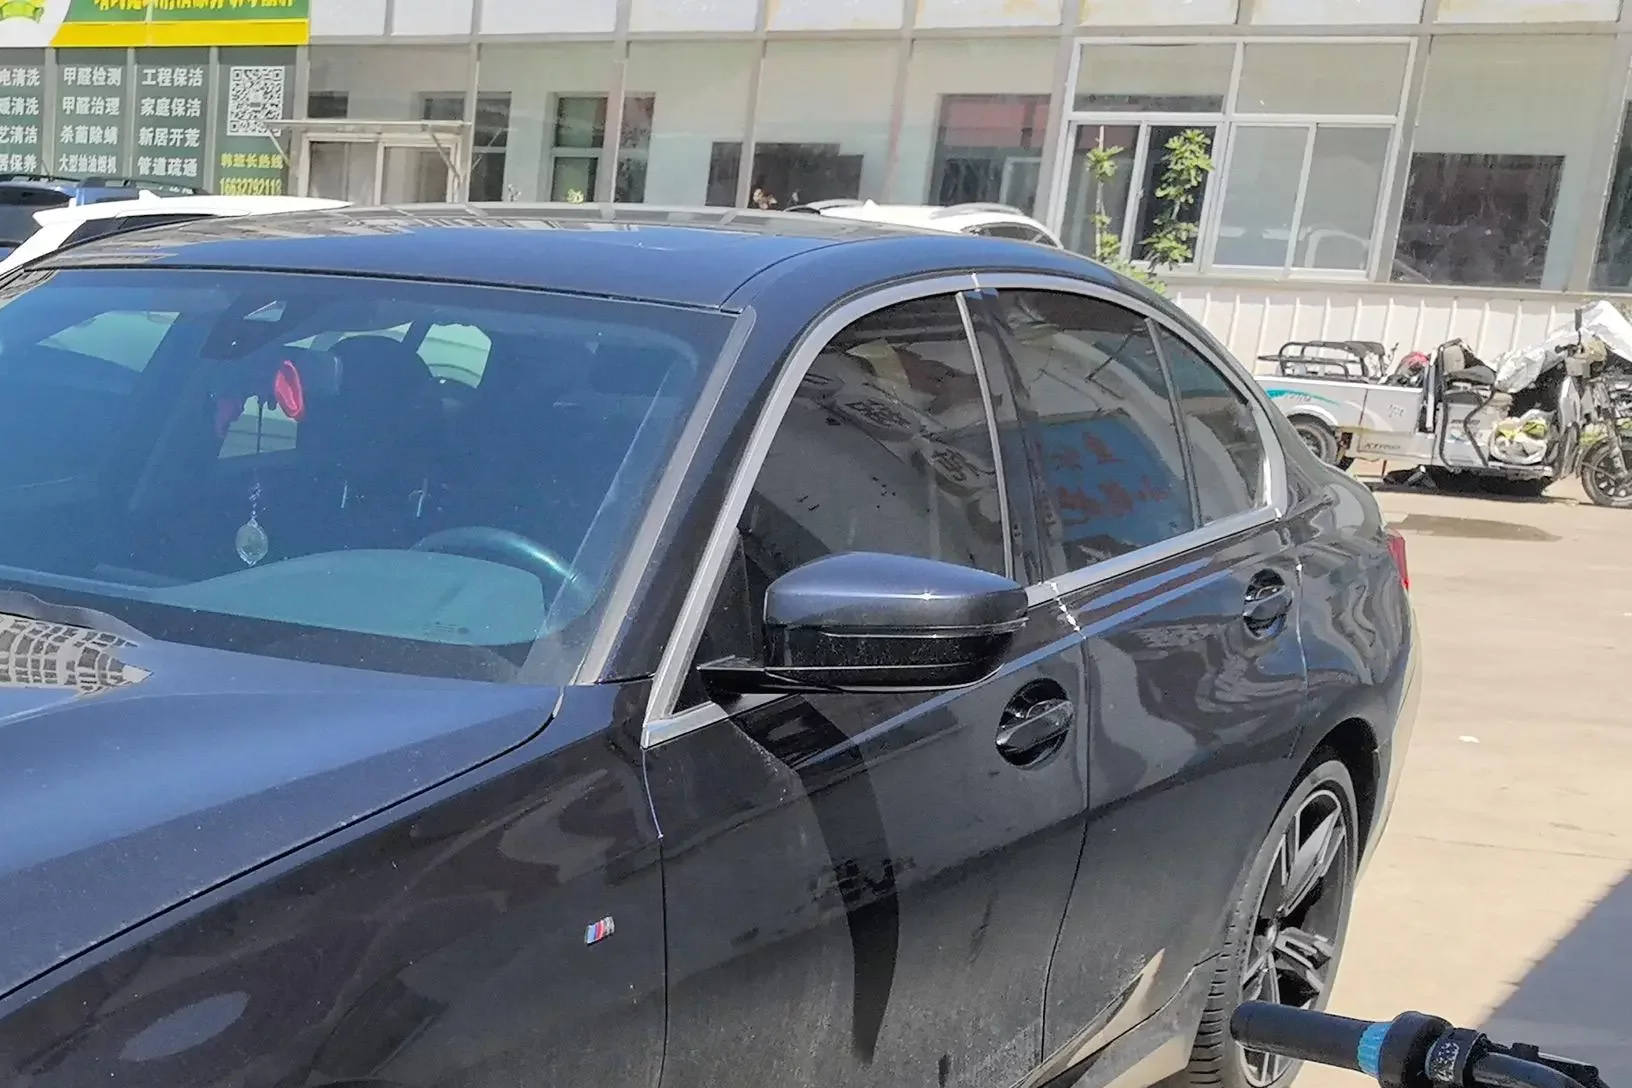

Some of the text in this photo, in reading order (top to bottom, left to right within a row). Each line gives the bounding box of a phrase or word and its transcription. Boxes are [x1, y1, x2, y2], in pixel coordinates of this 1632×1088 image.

[63, 67, 122, 86] 甲醛检测
[142, 68, 203, 87] 工程保洁
[62, 96, 120, 115] 甲醛治理
[140, 97, 202, 118] 家庭保洁
[60, 125, 118, 145] 杀菌除螨
[138, 127, 200, 147] 新居开荒
[137, 156, 198, 177] 管道疏通
